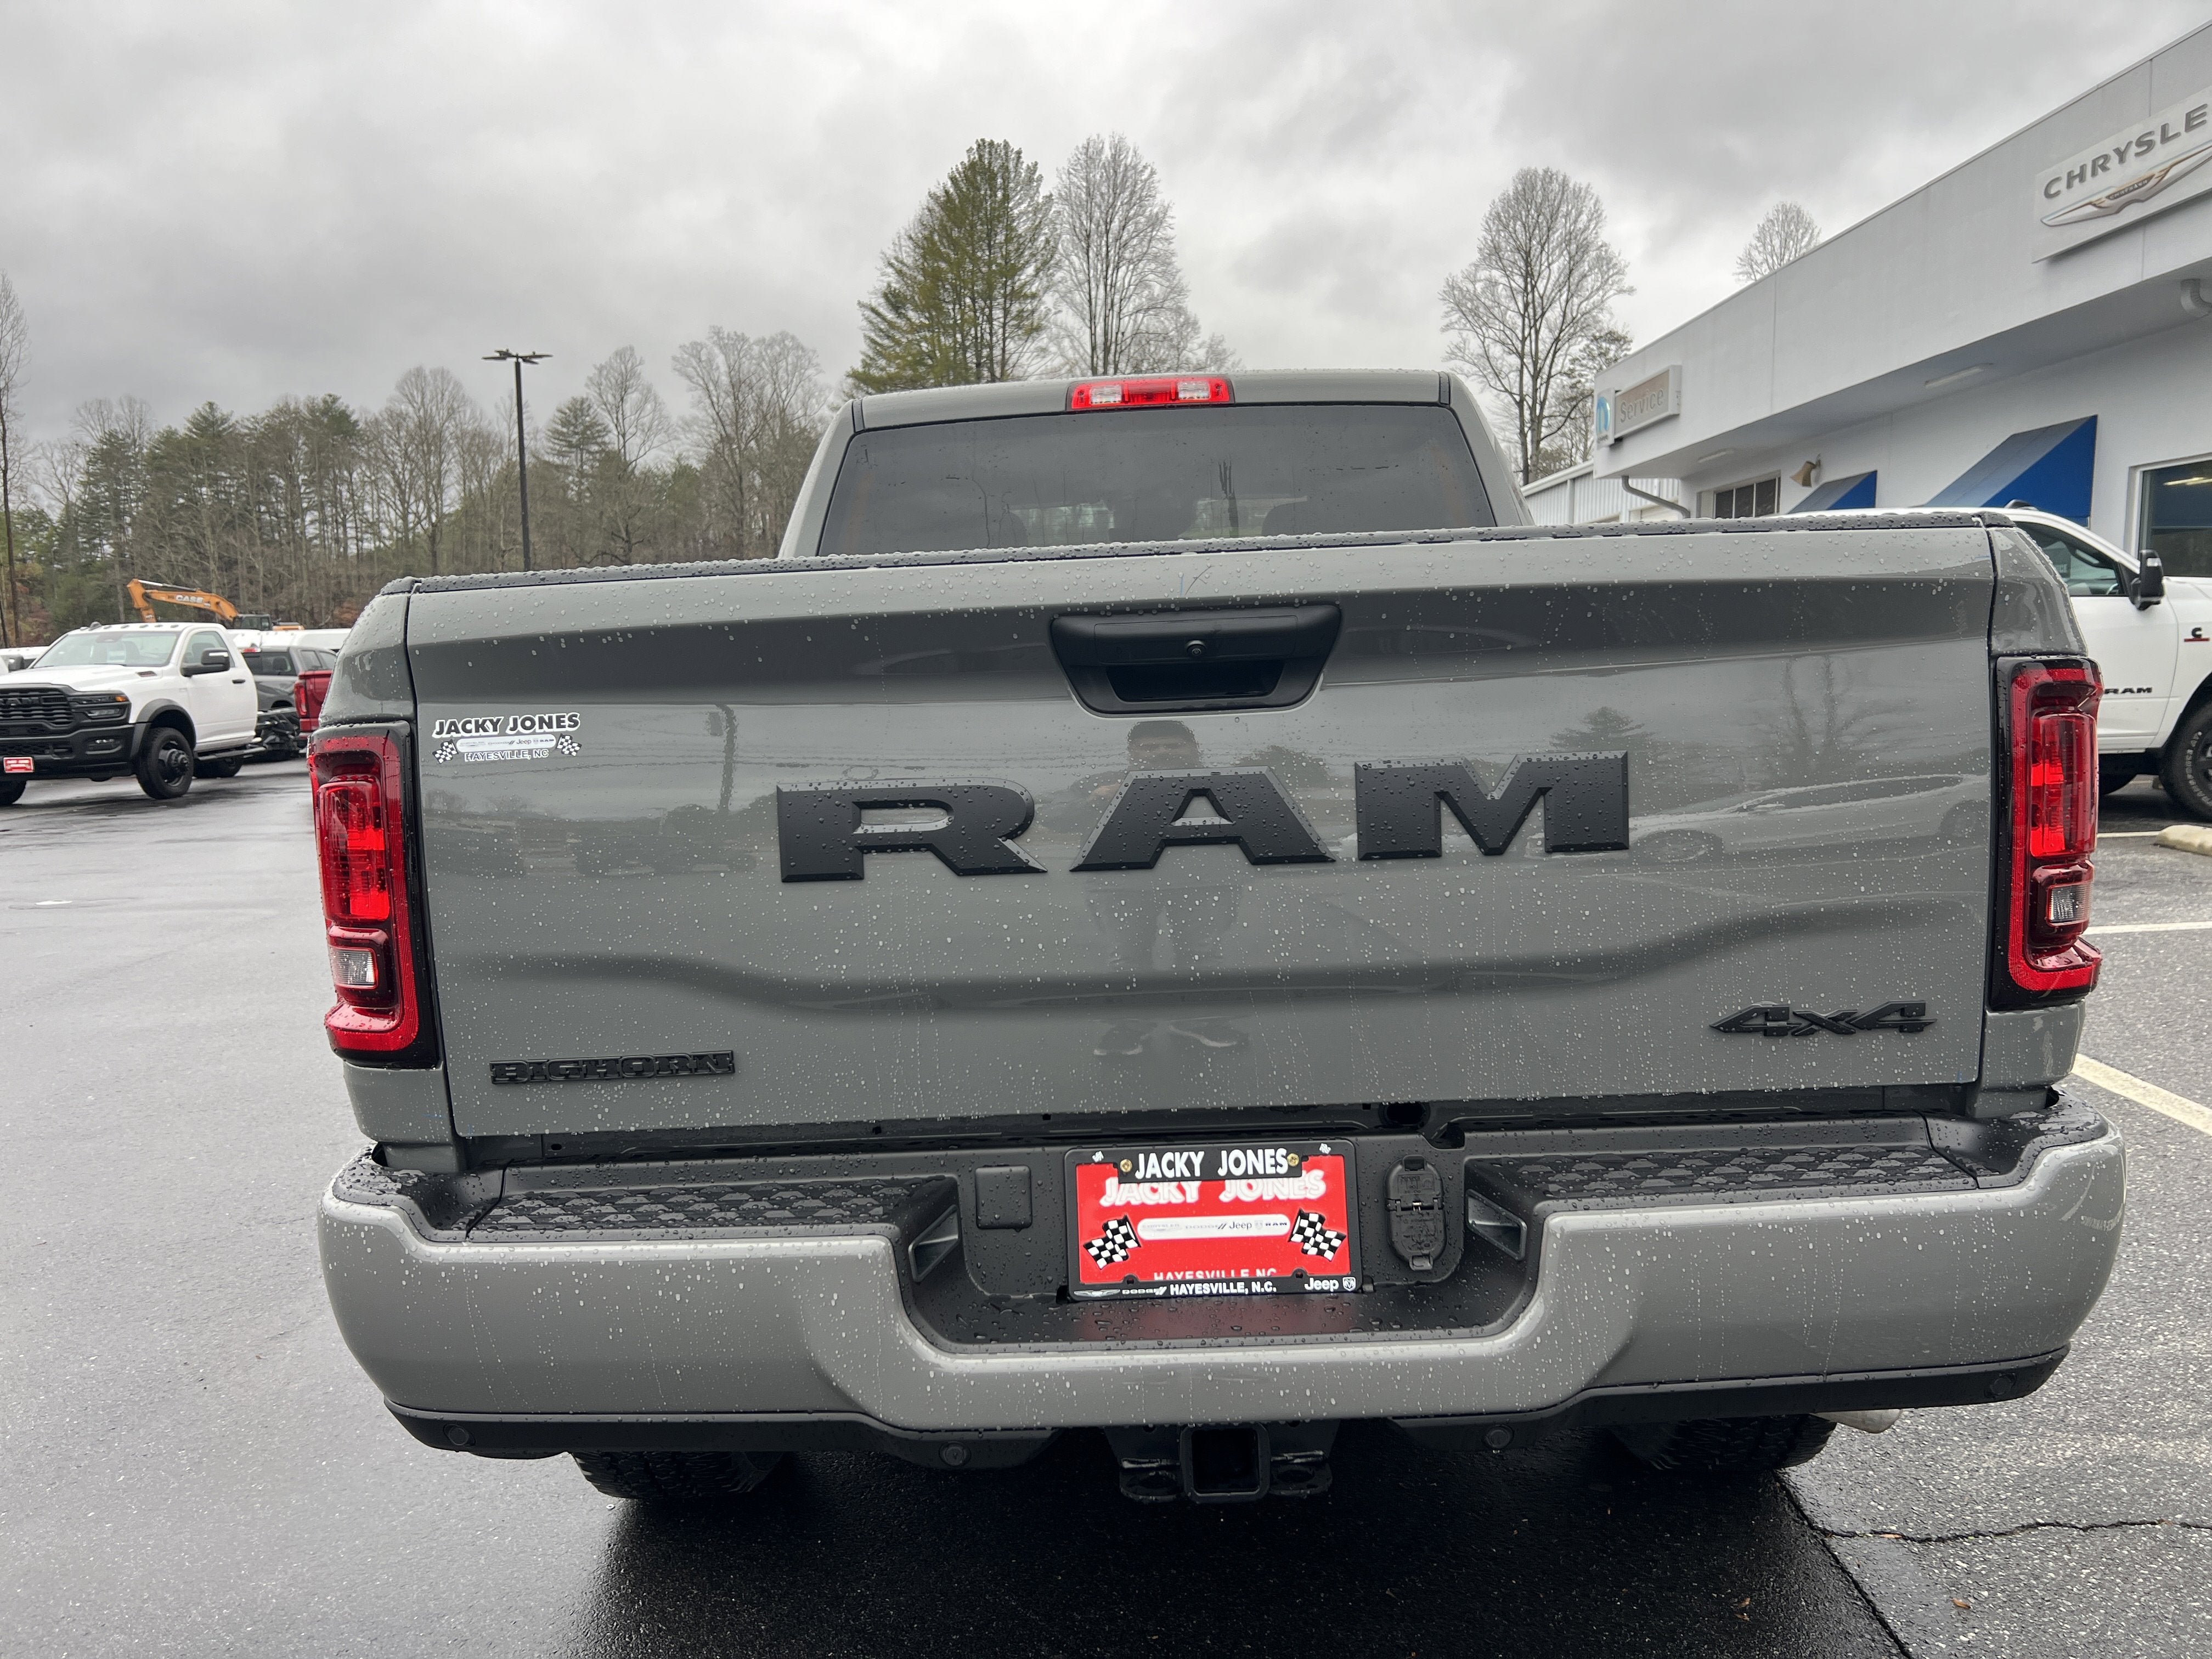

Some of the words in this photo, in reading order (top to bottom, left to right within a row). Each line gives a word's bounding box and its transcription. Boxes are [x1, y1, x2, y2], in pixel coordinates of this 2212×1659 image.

[1621, 388, 1664, 424] Service
[175, 594, 204, 603] CASE
[431, 716, 504, 738] JACKY
[505, 712, 580, 734] JONES
[465, 750, 531, 761] HAYESVILLE,
[533, 748, 549, 758] NC
[776, 749, 1630, 883] RAM
[1135, 1151, 1205, 1180] JACKY
[1217, 1148, 1288, 1176] JONES
[1099, 1177, 1203, 1207] JACKY
[1218, 1169, 1327, 1203] JONES
[1229, 1221, 1252, 1230] Jeep
[1256, 1268, 1277, 1277] NC
[1170, 1282, 1249, 1296] HAYESVILLE,
[1251, 1280, 1277, 1293] N.C.
[1304, 1277, 1339, 1292] Jeep
